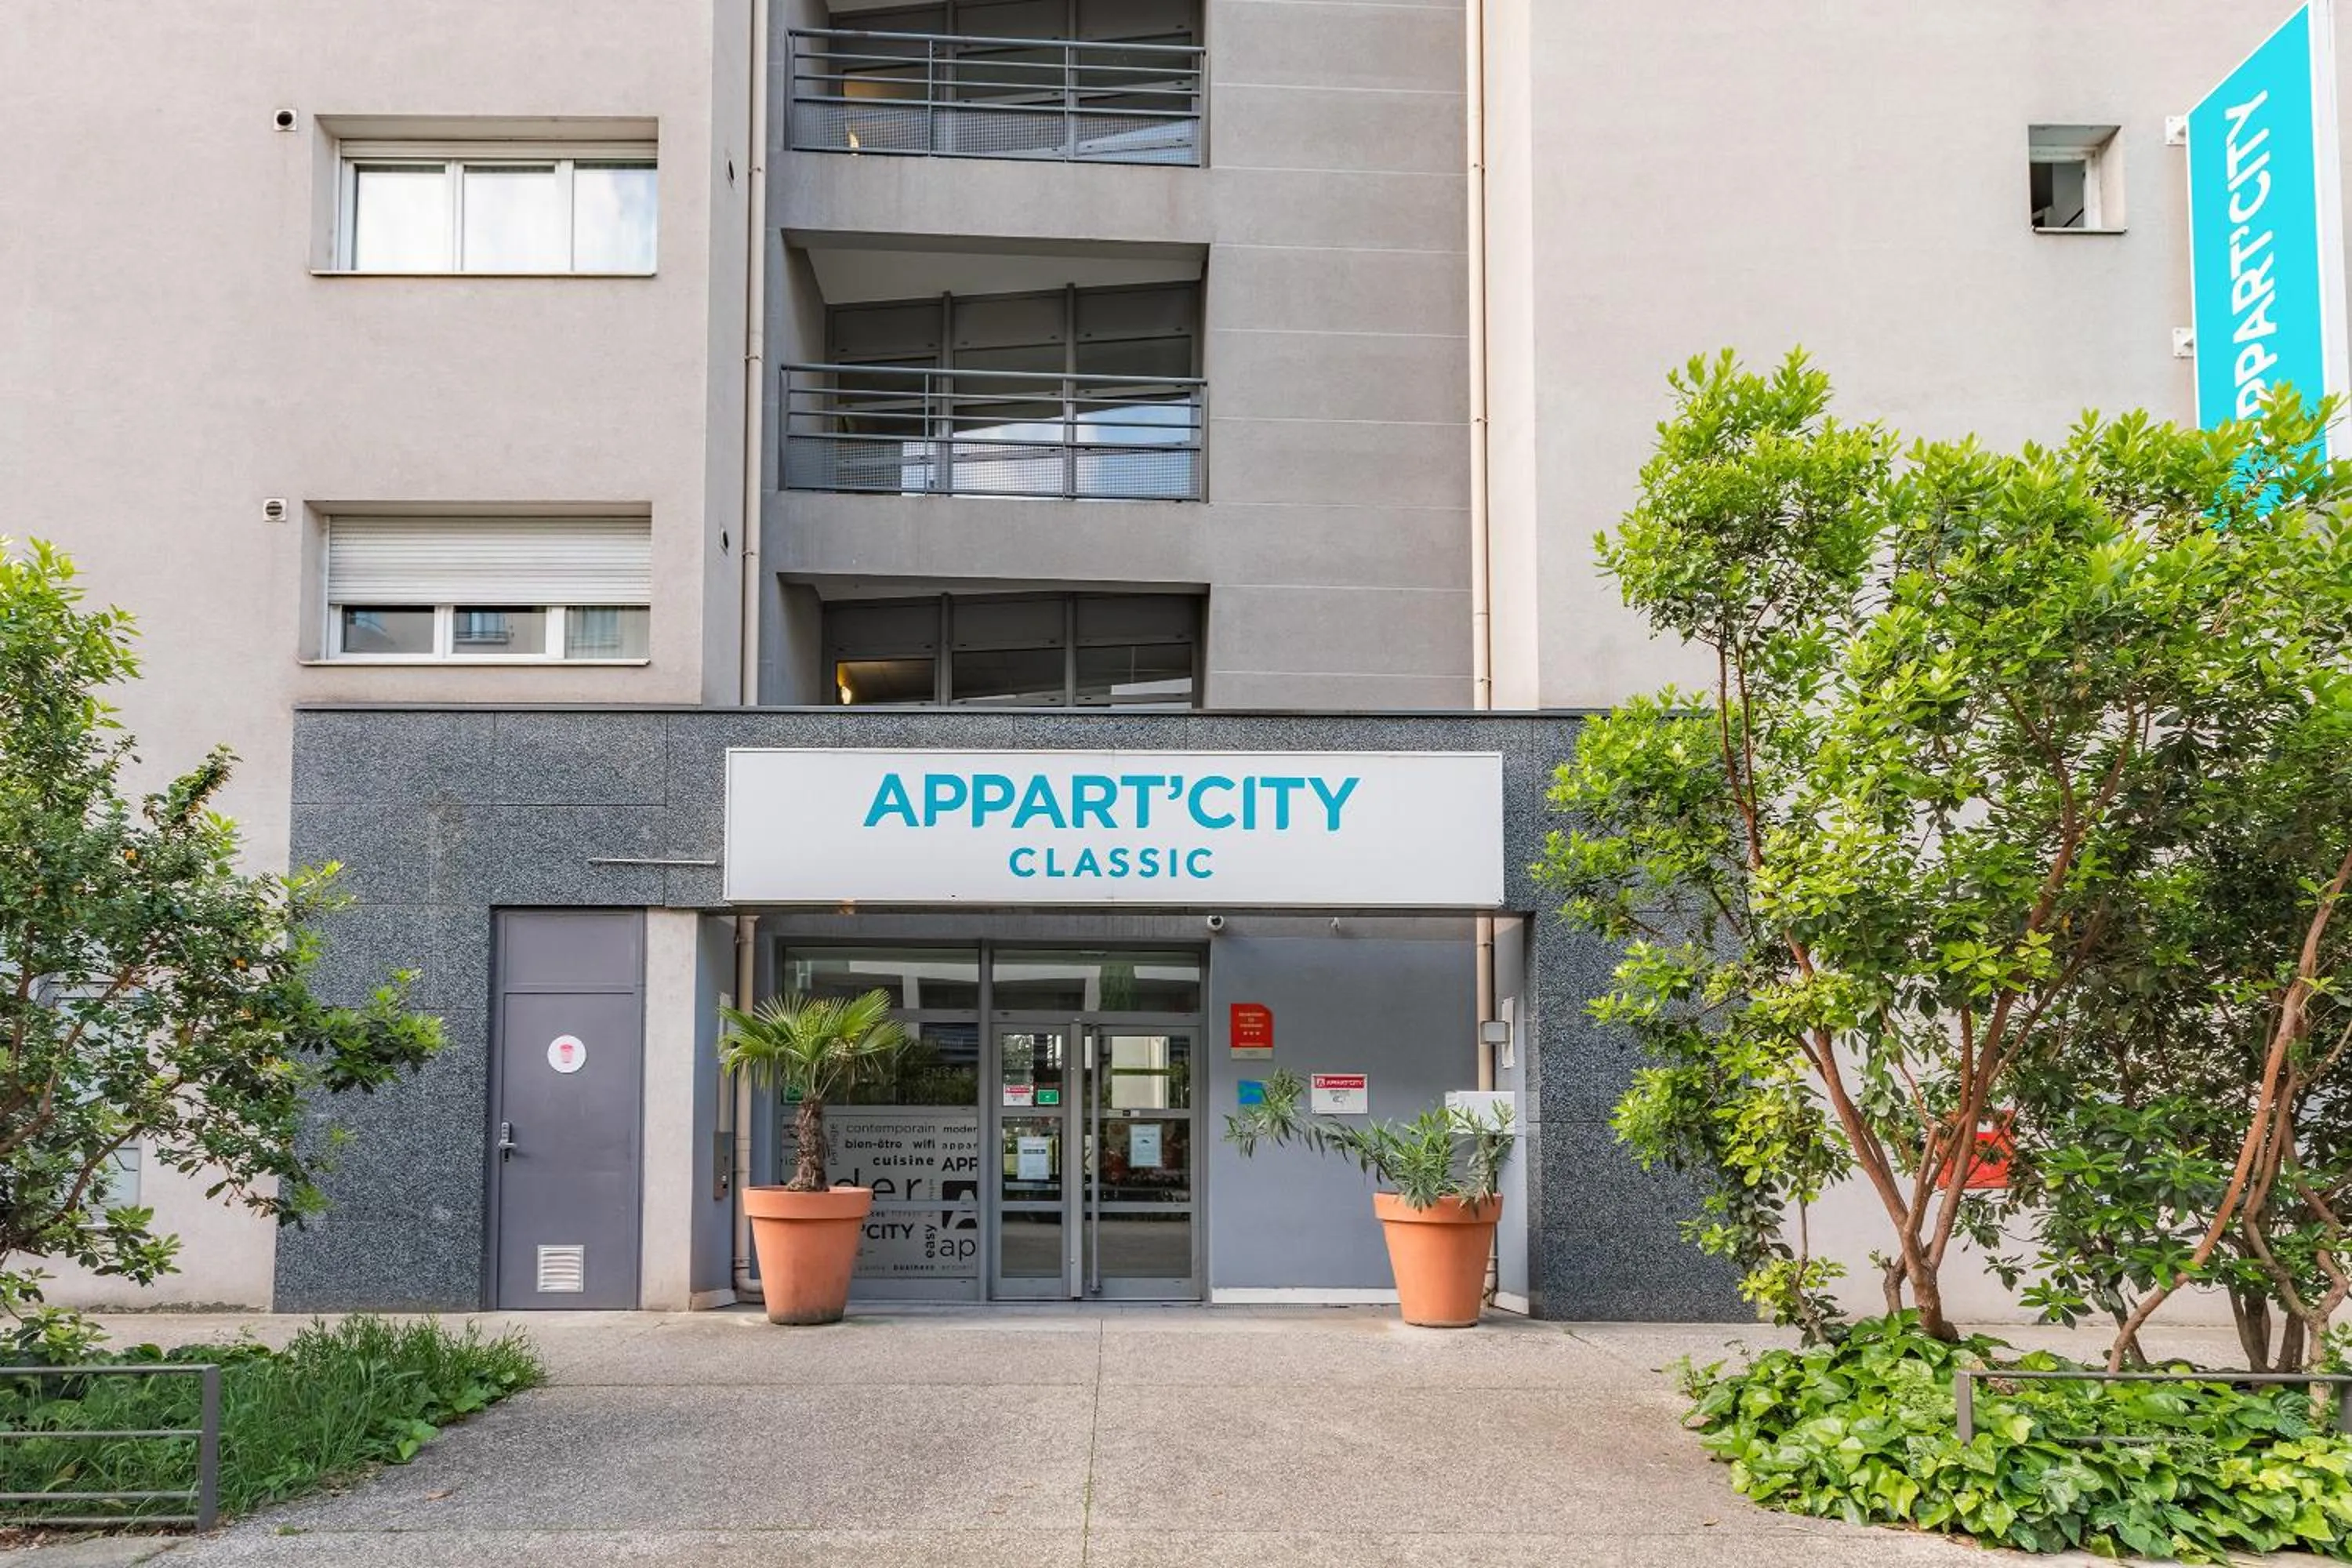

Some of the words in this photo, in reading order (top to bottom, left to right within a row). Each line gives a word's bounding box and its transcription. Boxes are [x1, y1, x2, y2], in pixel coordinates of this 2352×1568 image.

[2224, 89, 2280, 459] PPART'CITY
[865, 774, 1358, 830] APPART'CITY
[1010, 848, 1211, 878] CLASSIC
[846, 1124, 936, 1135] contemporain
[913, 1139, 935, 1149] wifi
[873, 1156, 935, 1166] cuisine
[925, 1224, 938, 1258] easy
[940, 1239, 976, 1261] ap
